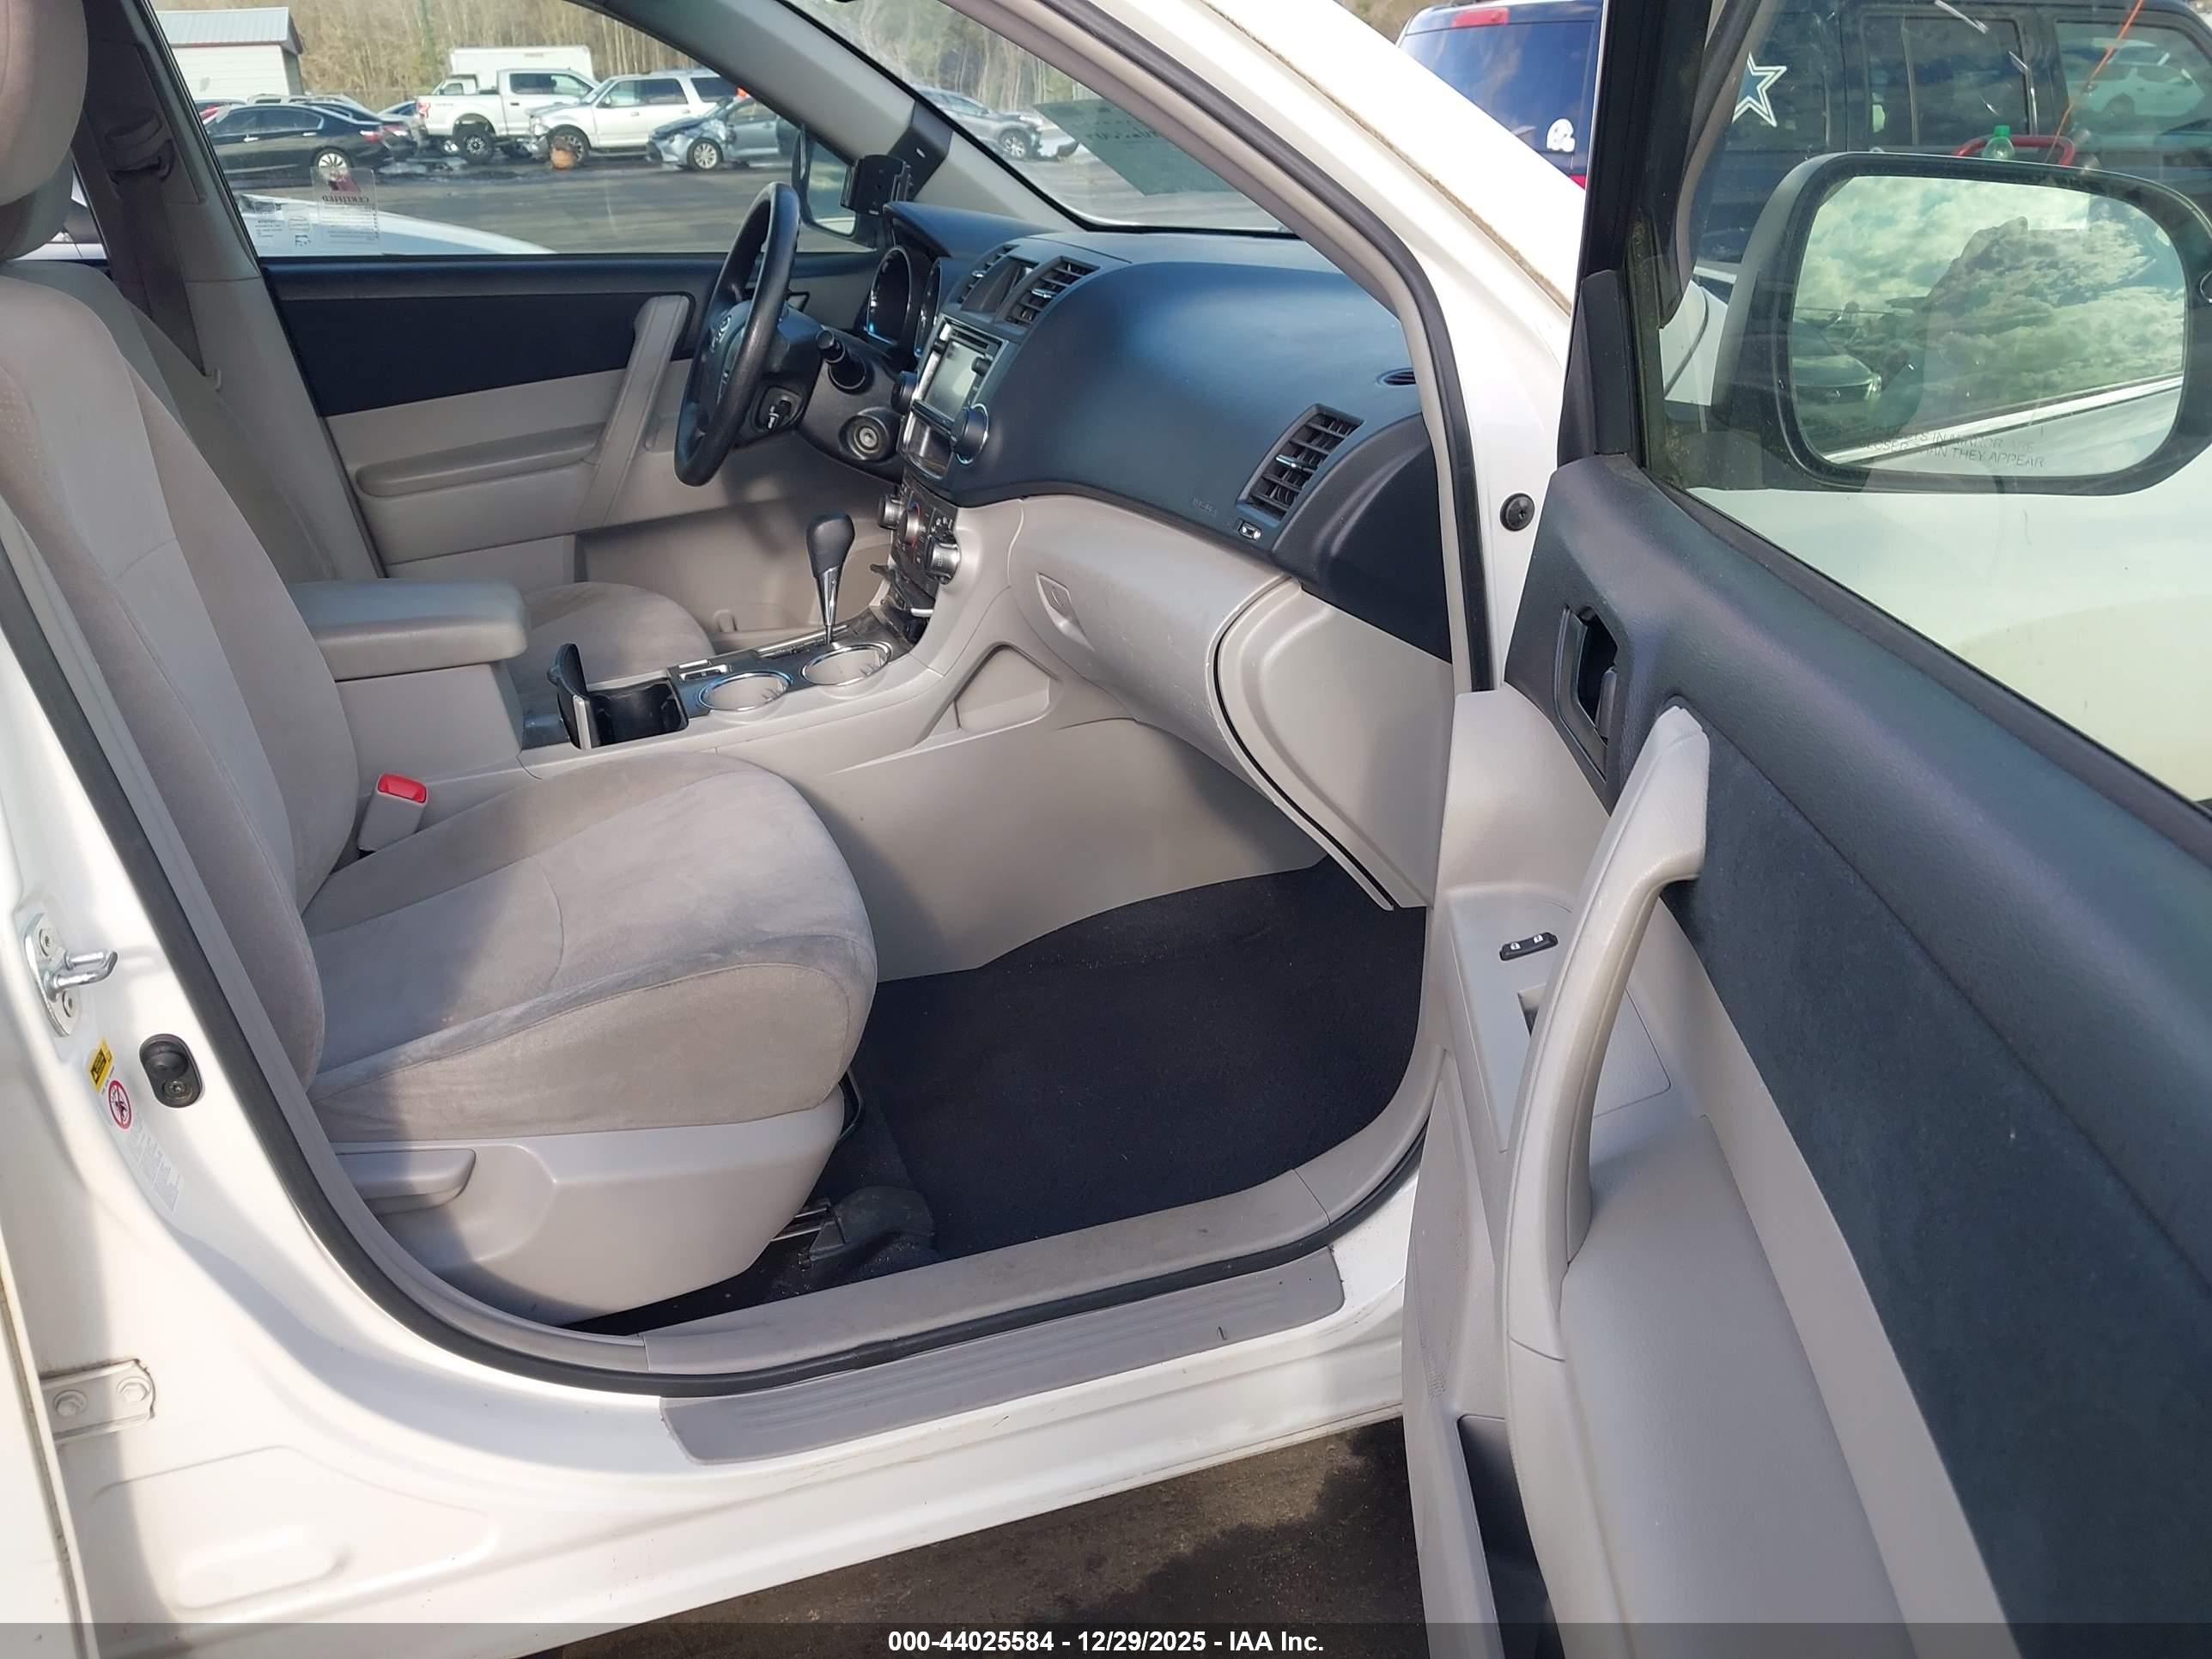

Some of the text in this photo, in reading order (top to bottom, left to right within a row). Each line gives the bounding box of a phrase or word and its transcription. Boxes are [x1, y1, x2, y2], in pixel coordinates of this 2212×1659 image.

[1931, 431, 1947, 444] IN
[1952, 447, 1988, 462] THEY
[1988, 451, 2046, 469] APPEAR
